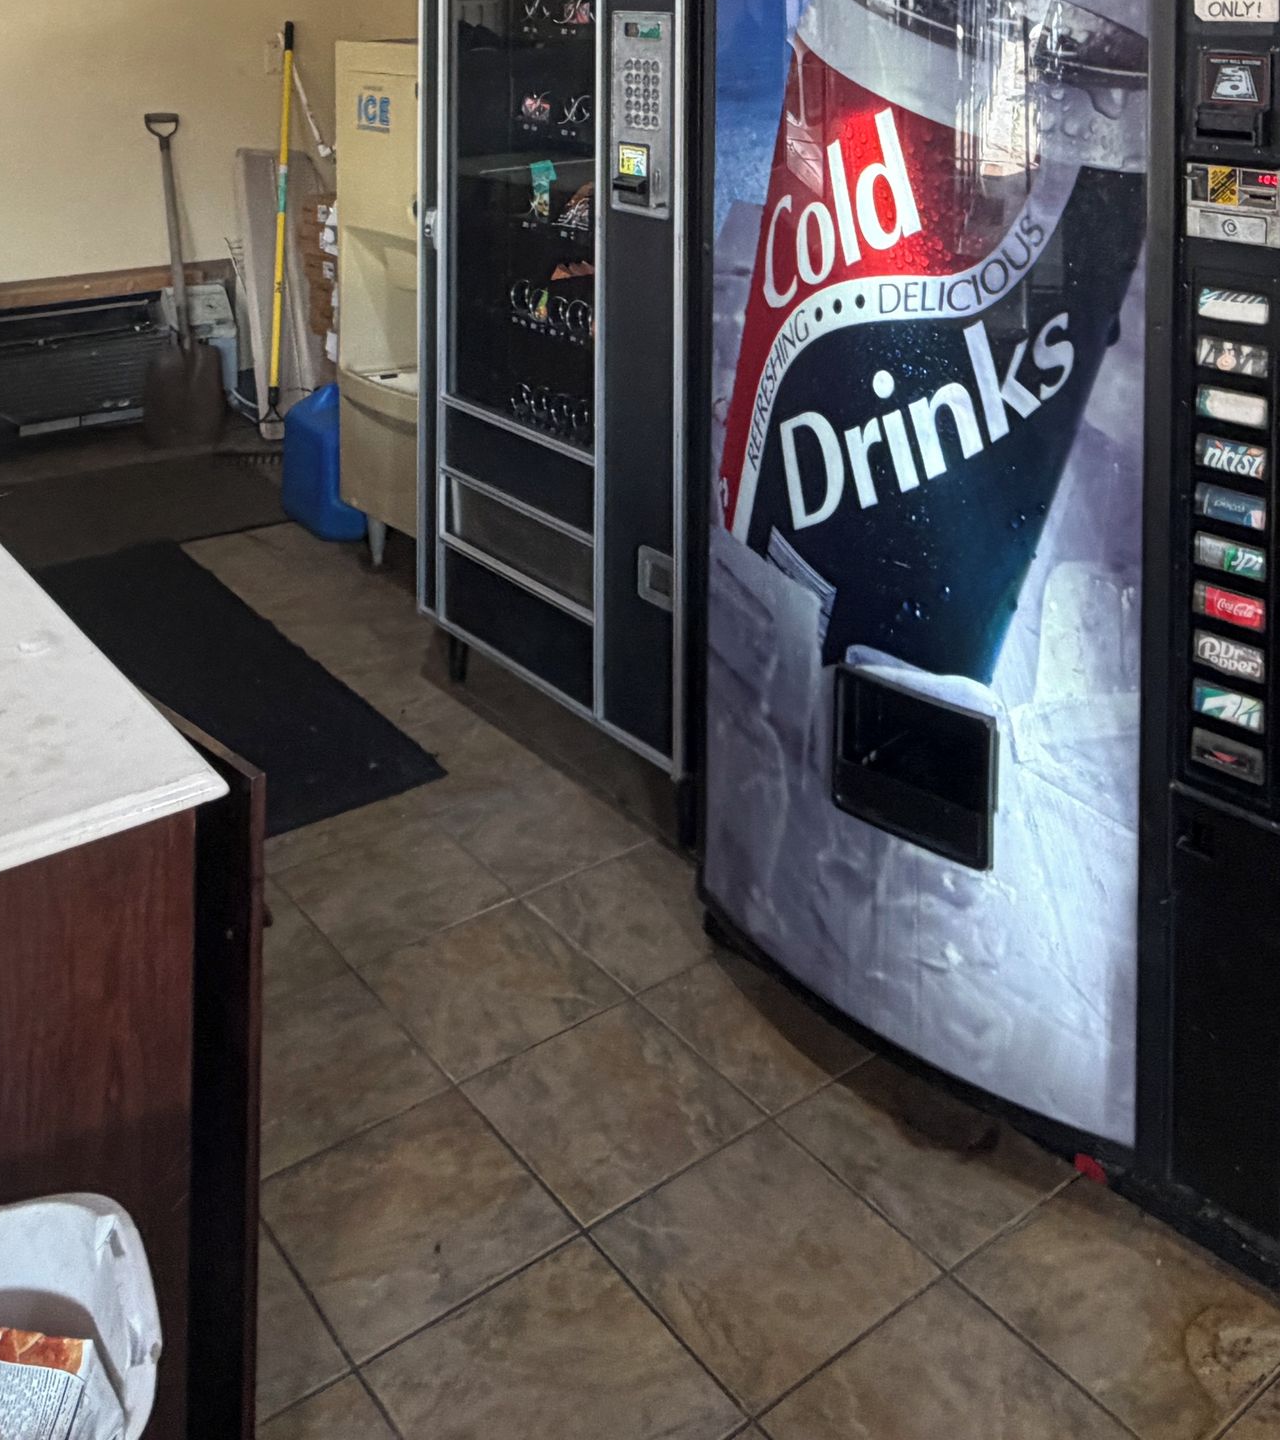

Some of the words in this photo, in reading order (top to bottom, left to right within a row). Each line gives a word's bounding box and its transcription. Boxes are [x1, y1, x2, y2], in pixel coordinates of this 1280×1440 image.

[356, 93, 391, 126] ICE
[1208, 1, 1262, 18] ONLY!
[761, 107, 922, 309] Cold
[747, 308, 810, 471] REFRESHING
[878, 214, 1045, 315] DELICIOUS
[780, 311, 1075, 531] Drinks
